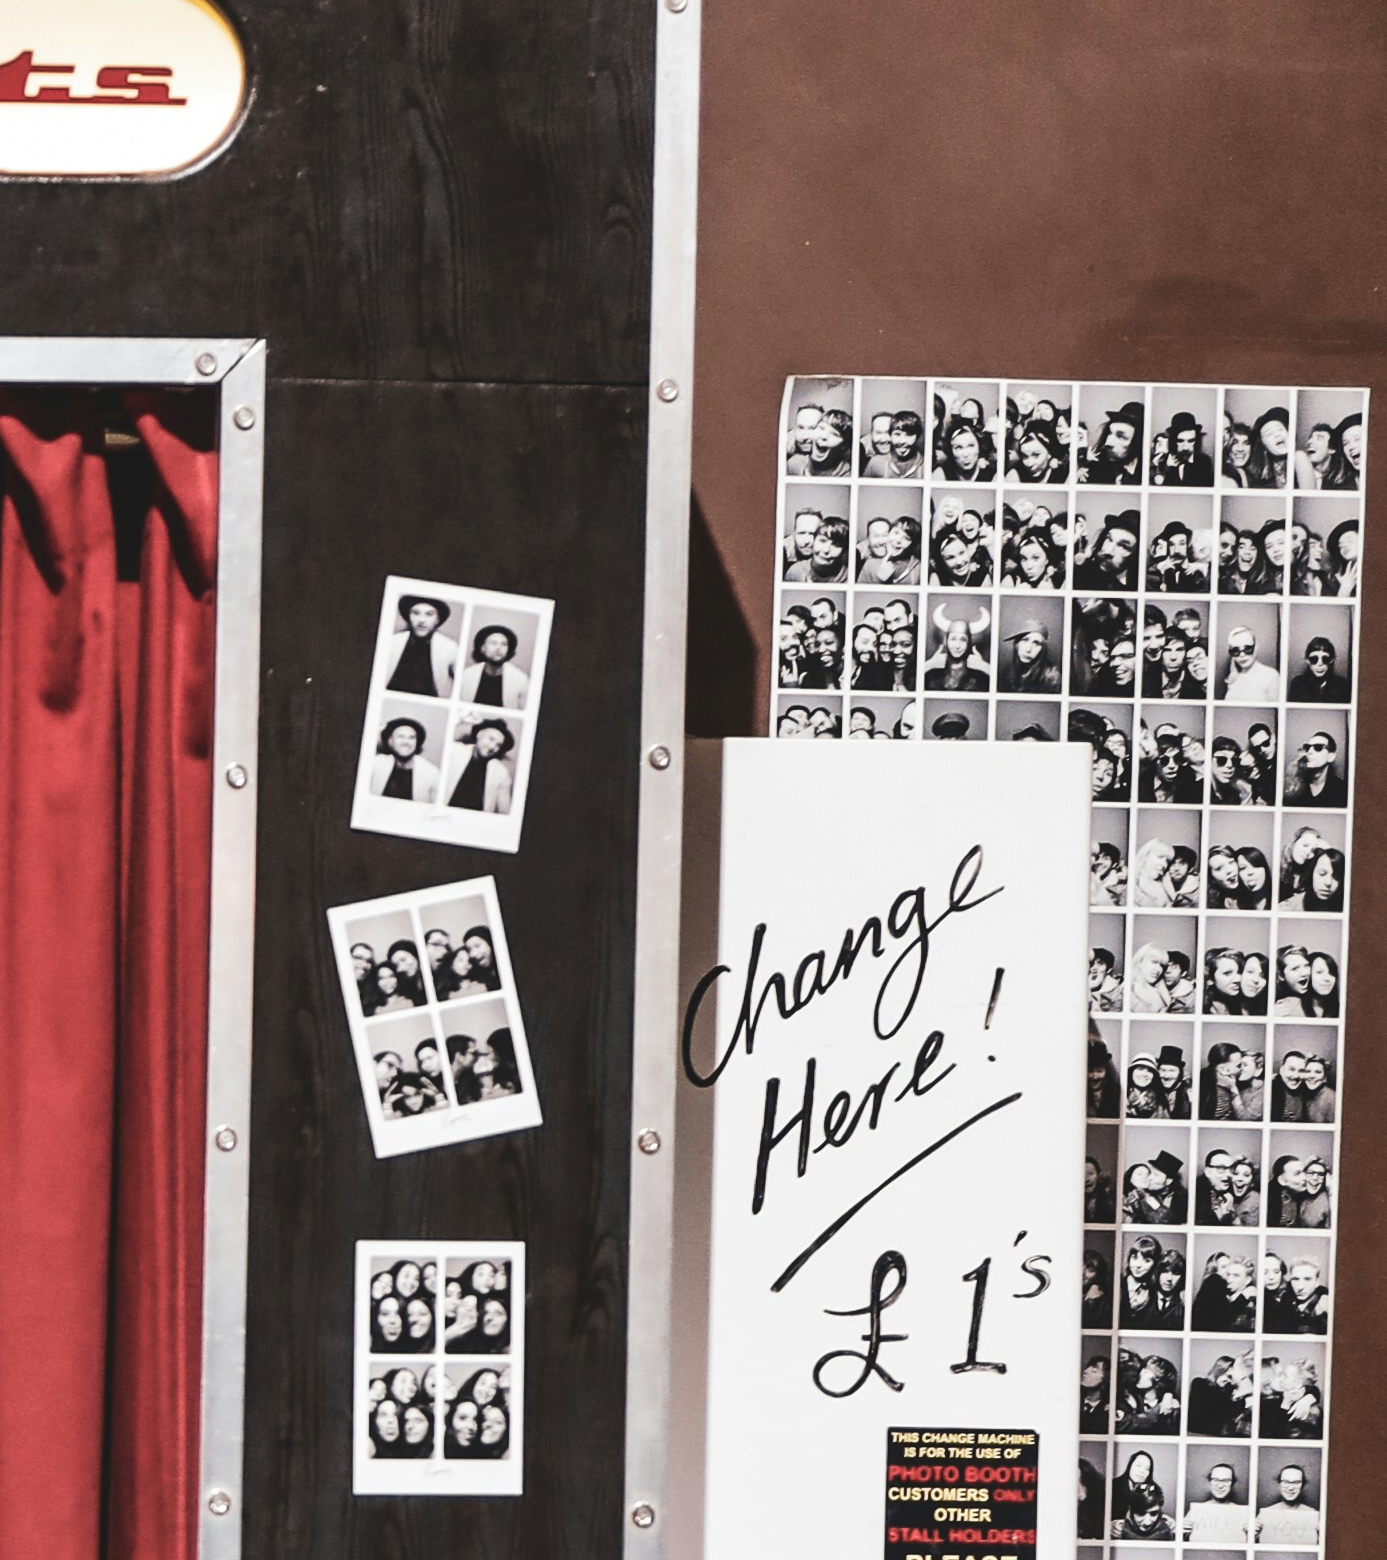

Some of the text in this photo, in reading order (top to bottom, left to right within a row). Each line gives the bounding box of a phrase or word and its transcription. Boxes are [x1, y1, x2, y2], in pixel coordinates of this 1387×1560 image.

[682, 843, 1005, 1088] Change
[751, 966, 1005, 1215] Here!
[890, 1431, 1036, 1446] THIS CHANGE MACHINE
[903, 1446, 1023, 1460] IS FOR THE USE OF
[887, 1465, 1036, 1484] PHOTO BOOTH
[887, 1486, 1035, 1503] CUSTOMERS ONLY
[933, 1507, 992, 1523] OTHER
[887, 1526, 1036, 1545] STALL HOLDERS
